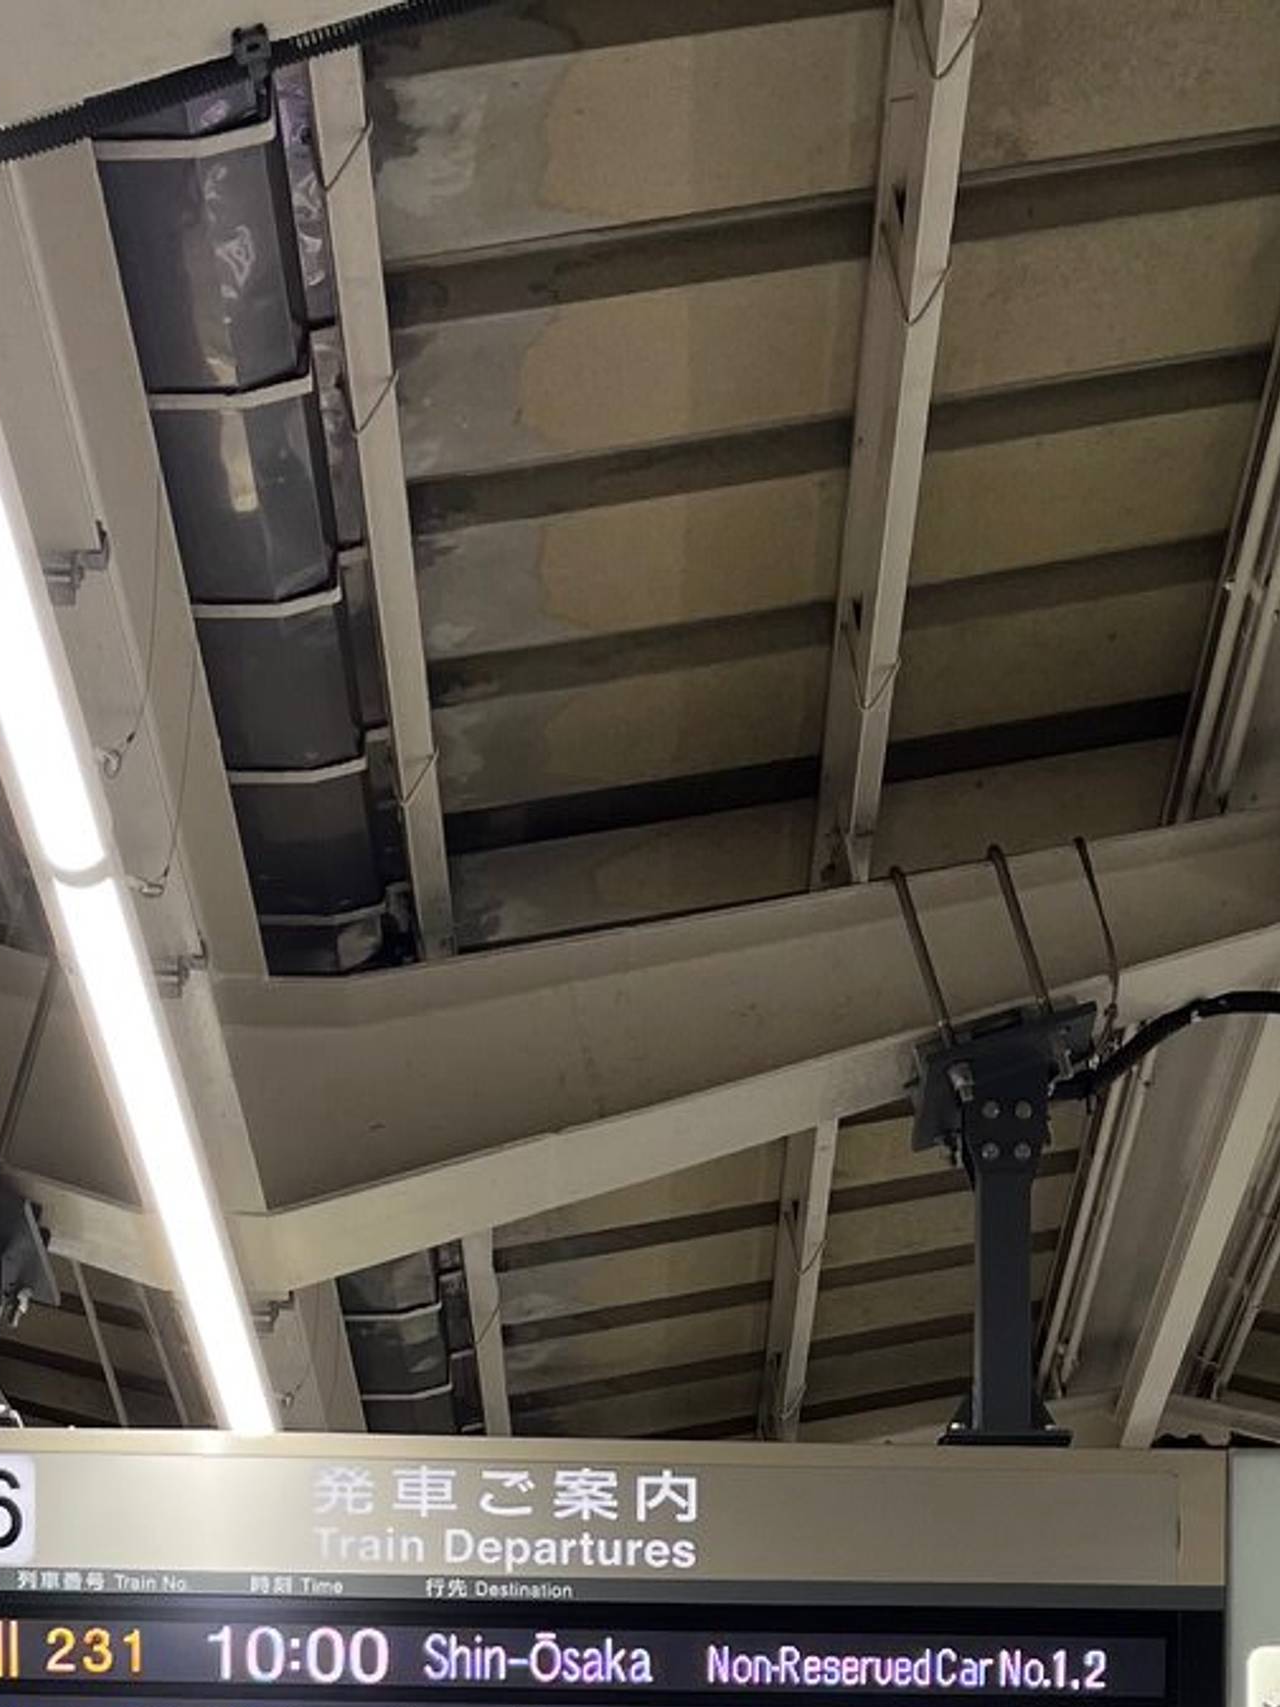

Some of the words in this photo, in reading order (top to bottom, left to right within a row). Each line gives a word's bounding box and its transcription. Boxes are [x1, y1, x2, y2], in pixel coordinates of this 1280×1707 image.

[314, 1466, 698, 1522] 発車ご案内
[314, 1527, 425, 1563] Train
[445, 1529, 697, 1572] Departures
[17, 1570, 105, 1590] 列車番号
[114, 1573, 157, 1591] Train
[249, 1575, 293, 1594] 時刻
[299, 1577, 344, 1595] Time
[425, 1579, 467, 1598] 行先
[474, 1580, 573, 1599] Destination
[47, 1628, 140, 1672] 231
[207, 1624, 388, 1684] 10:00
[424, 1633, 652, 1683] Shin-Ōsaka
